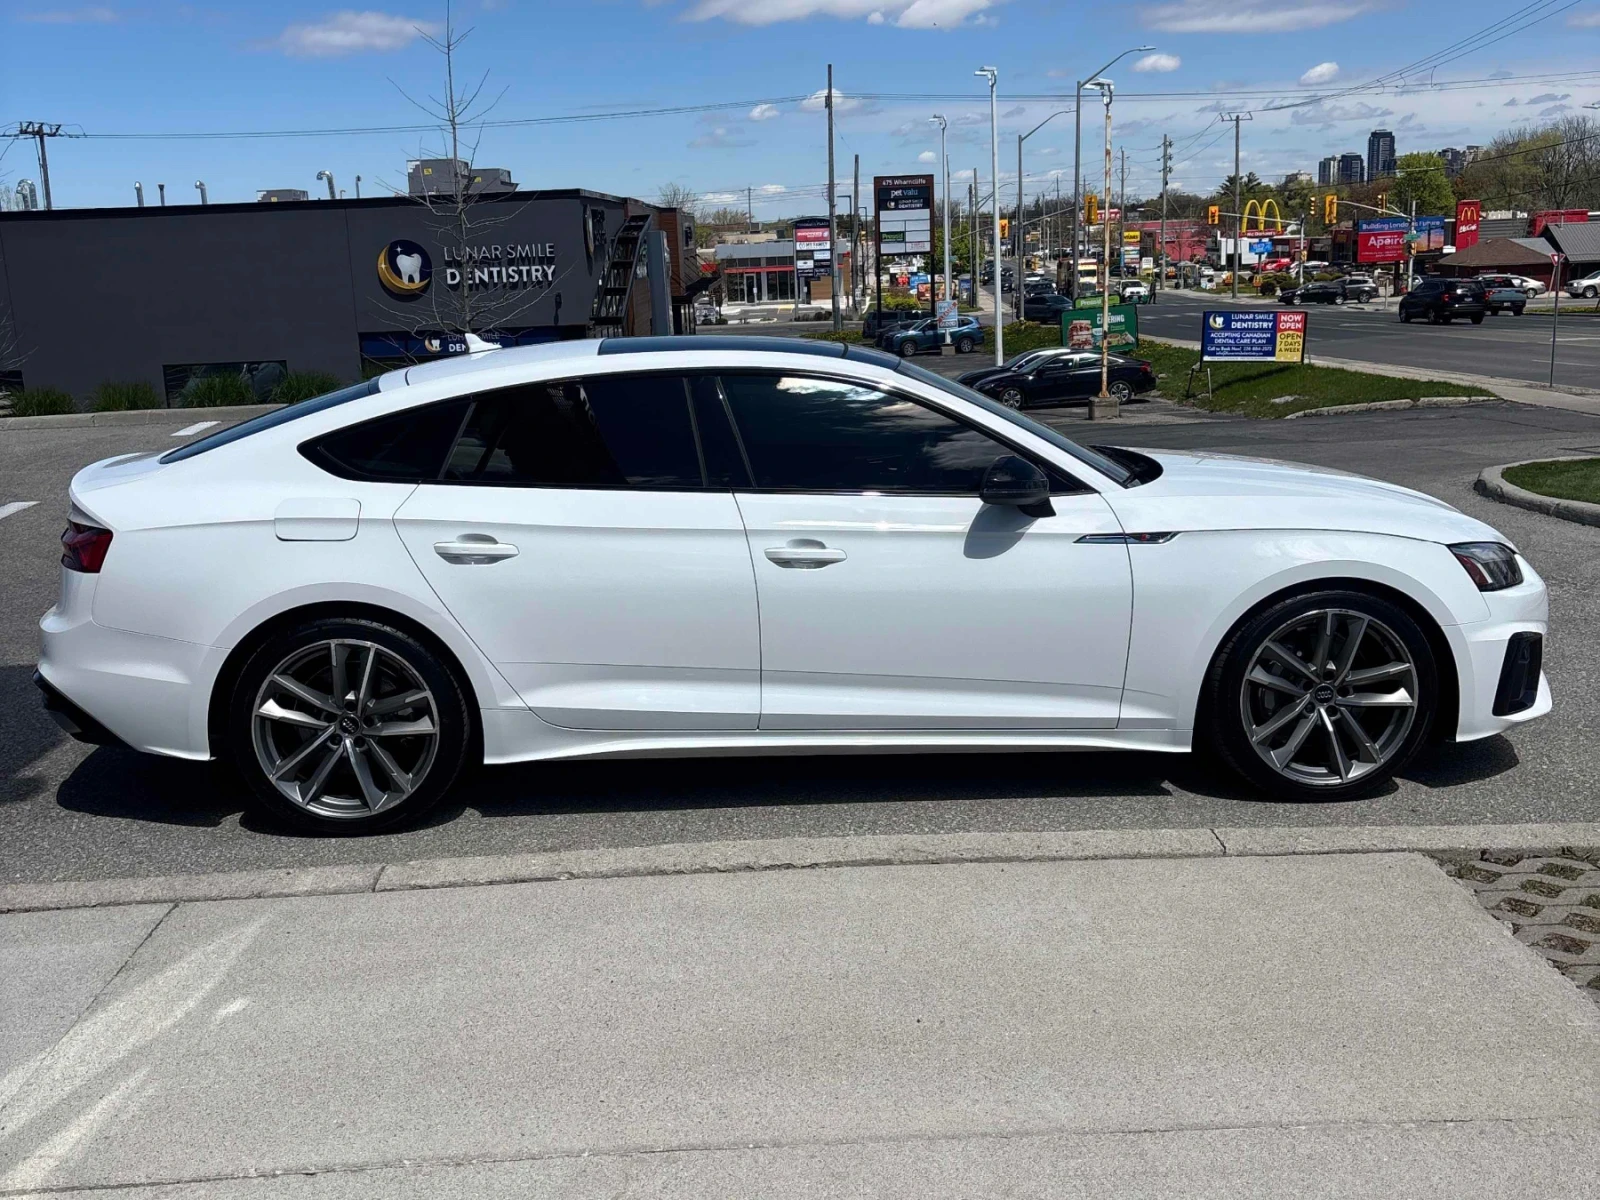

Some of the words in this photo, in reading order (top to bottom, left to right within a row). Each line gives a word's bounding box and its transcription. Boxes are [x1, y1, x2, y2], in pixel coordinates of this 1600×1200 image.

[891, 189, 903, 198] pet
[903, 188, 918, 196] valu
[1362, 222, 1389, 230] Building
[1389, 221, 1418, 229] Londos
[444, 245, 502, 260] LUNAR
[507, 243, 555, 258] SMILE
[446, 265, 555, 284] DENTISTRY
[1097, 314, 1125, 325] CAERING
[1281, 314, 1302, 322] NOW
[1231, 321, 1273, 329] DENTISTRY
